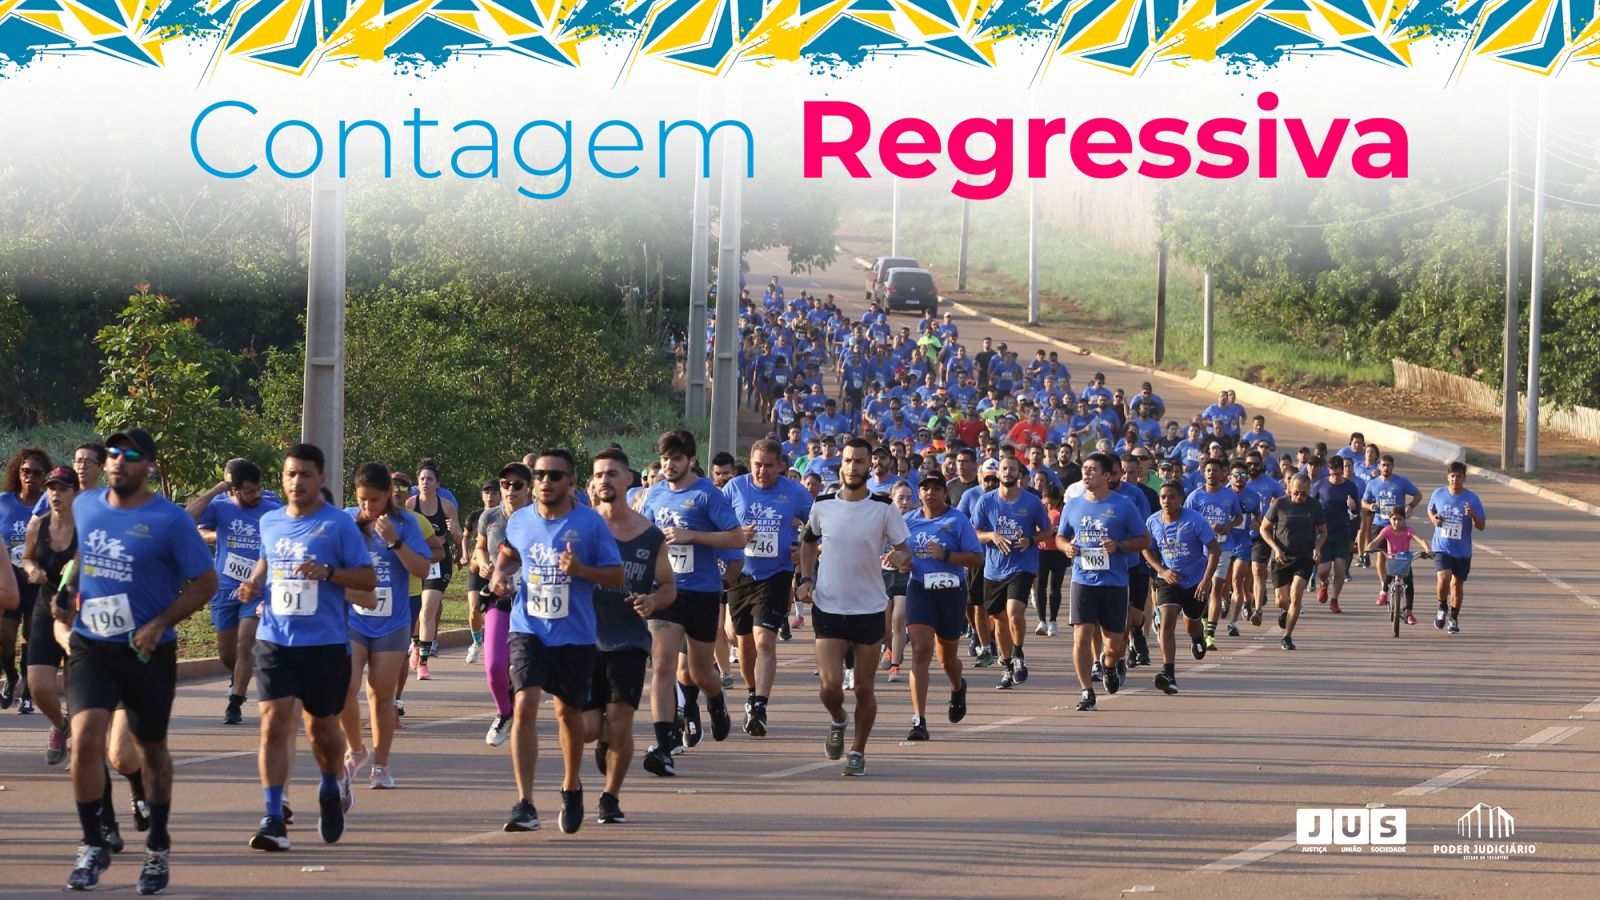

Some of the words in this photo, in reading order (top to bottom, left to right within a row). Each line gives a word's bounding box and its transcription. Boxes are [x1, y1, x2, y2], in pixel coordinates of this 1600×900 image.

[750, 540, 774, 553] 746
[83, 555, 133, 572] CORRIDA
[671, 554, 687, 569] 77
[93, 569, 133, 582] JUSTIÇA
[229, 562, 252, 579] 980
[624, 561, 647, 581] RPH
[283, 592, 302, 610] 91
[532, 595, 562, 614] 819
[91, 608, 125, 631] 196
